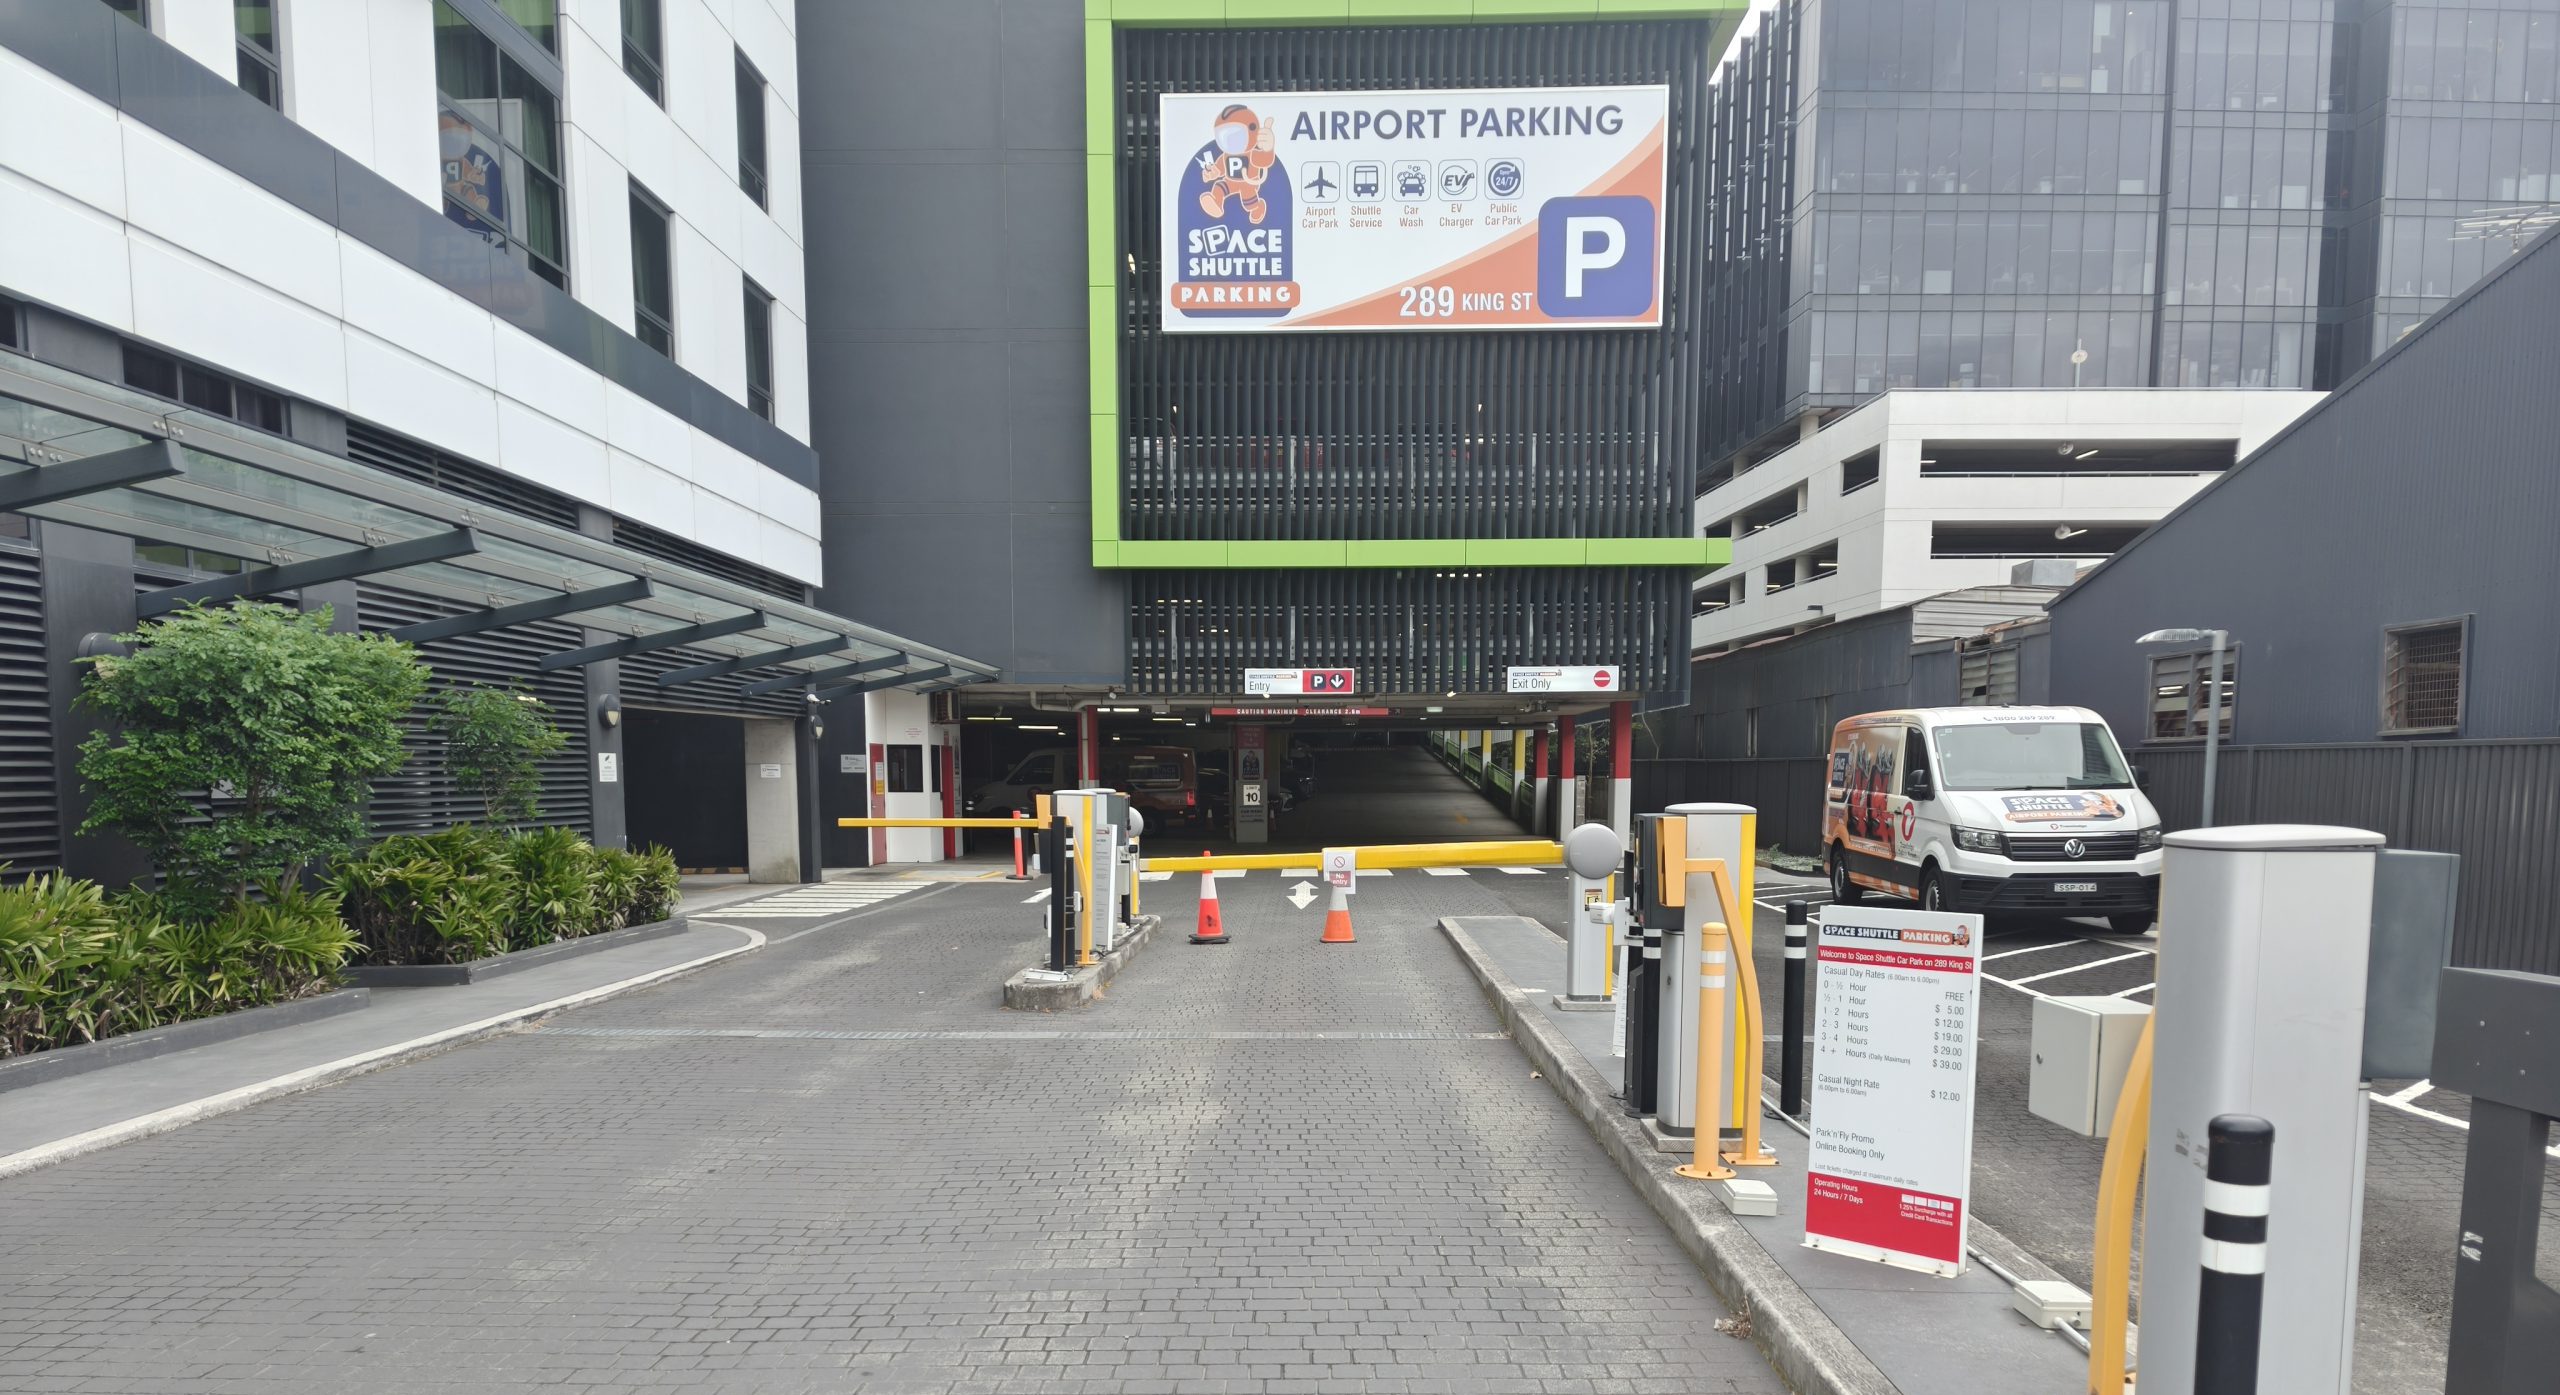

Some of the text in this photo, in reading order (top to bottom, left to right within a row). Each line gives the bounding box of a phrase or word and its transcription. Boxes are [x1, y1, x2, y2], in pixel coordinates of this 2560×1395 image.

[1290, 104, 1623, 141] AIRPORT PARKING
[1229, 157, 1242, 177] P
[1495, 176, 1514, 186] 24/7
[1305, 205, 1336, 218] Airport
[1351, 205, 1382, 216] Shuttle
[1403, 205, 1419, 215] Car
[1451, 204, 1462, 213] EV
[1490, 203, 1518, 213] Public
[1302, 218, 1339, 229] Car Park
[1349, 217, 1383, 228] Service
[1399, 217, 1424, 227] Wash
[1439, 217, 1474, 229] Charger
[1485, 215, 1522, 226] Car Park
[1188, 228, 1282, 253] SPACE
[1565, 216, 1626, 298] P
[1189, 257, 1282, 276] SHUTTLE
[1181, 286, 1291, 303] PARKING
[1399, 286, 1533, 317] 289 KING ST
[1249, 681, 1270, 691] Entry
[1313, 675, 1324, 688] P
[1512, 678, 1551, 690] Exit Only
[1245, 792, 1258, 802] 10
[2015, 803, 2074, 811] SHUTTLE
[2008, 811, 2049, 819] AIRPORT
[1825, 925, 1951, 943] SPACE SHUTTLE PARKING
[1820, 949, 1973, 970] Welcome to Space Shuttle Car Park on 289 King St
[1824, 965, 1847, 976] Casual
[1849, 967, 1864, 979] Day
[1865, 969, 1885, 979] Rates
[1824, 980, 1829, 988] 0
[1849, 982, 1867, 992] Hour
[1838, 994, 1842, 1002] 1
[1849, 995, 1866, 1005] Hour
[1945, 991, 1965, 1001] FREE
[1823, 1006, 1827, 1014] 1
[1834, 1007, 1840, 1016] 2
[1848, 1008, 1869, 1019] Hours
[1935, 1004, 1965, 1015] $ 5.00
[1822, 1019, 1827, 1027] 2
[1834, 1020, 1839, 1029] 3
[1847, 1022, 1869, 1032] Hours
[1934, 1018, 1964, 1029] $ 12.00
[1821, 1032, 1827, 1041] 3
[1833, 1033, 1838, 1042] 4
[1846, 1035, 1868, 1045] Hours
[1934, 1031, 1963, 1043] $ 19.00
[1820, 1045, 1826, 1053] 4
[1845, 1048, 1867, 1059] Hours
[1868, 1053, 1883, 1062] (Daily
[1884, 1055, 1911, 1065] Maximum)
[1933, 1045, 1962, 1056] $ 29.00
[1932, 1059, 1962, 1071] $ 39.00
[1818, 1073, 1880, 1089] Casual Night Rate
[1930, 1089, 1960, 1102] $ 12.00
[1851, 1133, 1875, 1144] Promo
[1815, 1141, 1885, 1161] Online Booking Only
[1842, 1167, 1862, 1176] charged
[1868, 1171, 1892, 1181] maximum
[1893, 1176, 1905, 1184] daily
[1814, 1177, 1858, 1191] Operating Hours
[1813, 1188, 1821, 1196] 24
[1822, 1189, 1839, 1199] Hours
[1849, 1194, 1863, 1204] Days
[1900, 1210, 1914, 1219] Credit
[1914, 1213, 1925, 1221] Card
